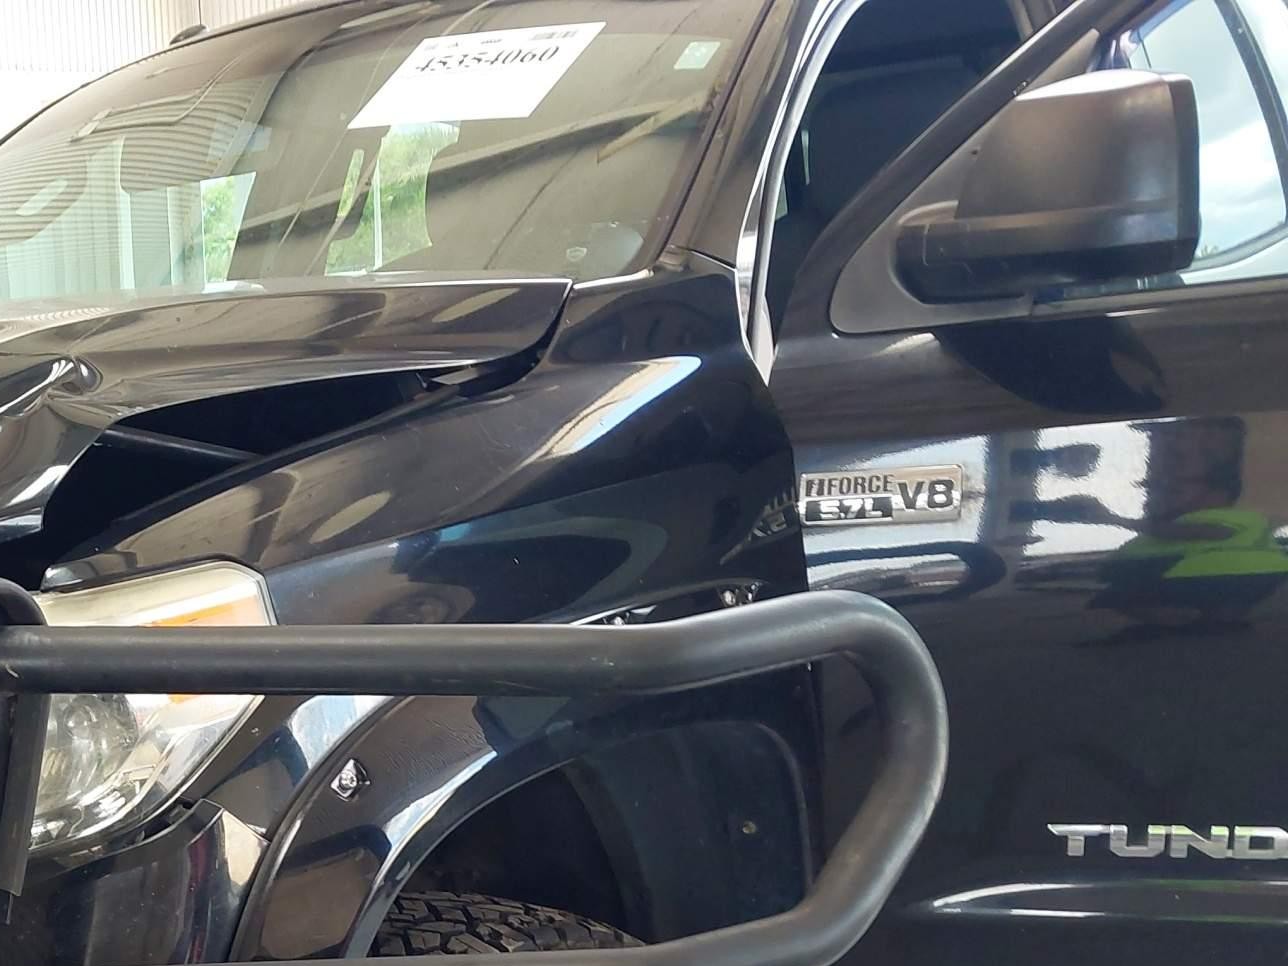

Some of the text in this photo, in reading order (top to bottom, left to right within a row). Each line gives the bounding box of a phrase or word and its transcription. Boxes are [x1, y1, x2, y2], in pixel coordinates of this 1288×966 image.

[416, 46, 560, 72] 45354060
[896, 479, 954, 511] V8
[819, 499, 882, 520] 5.7L
